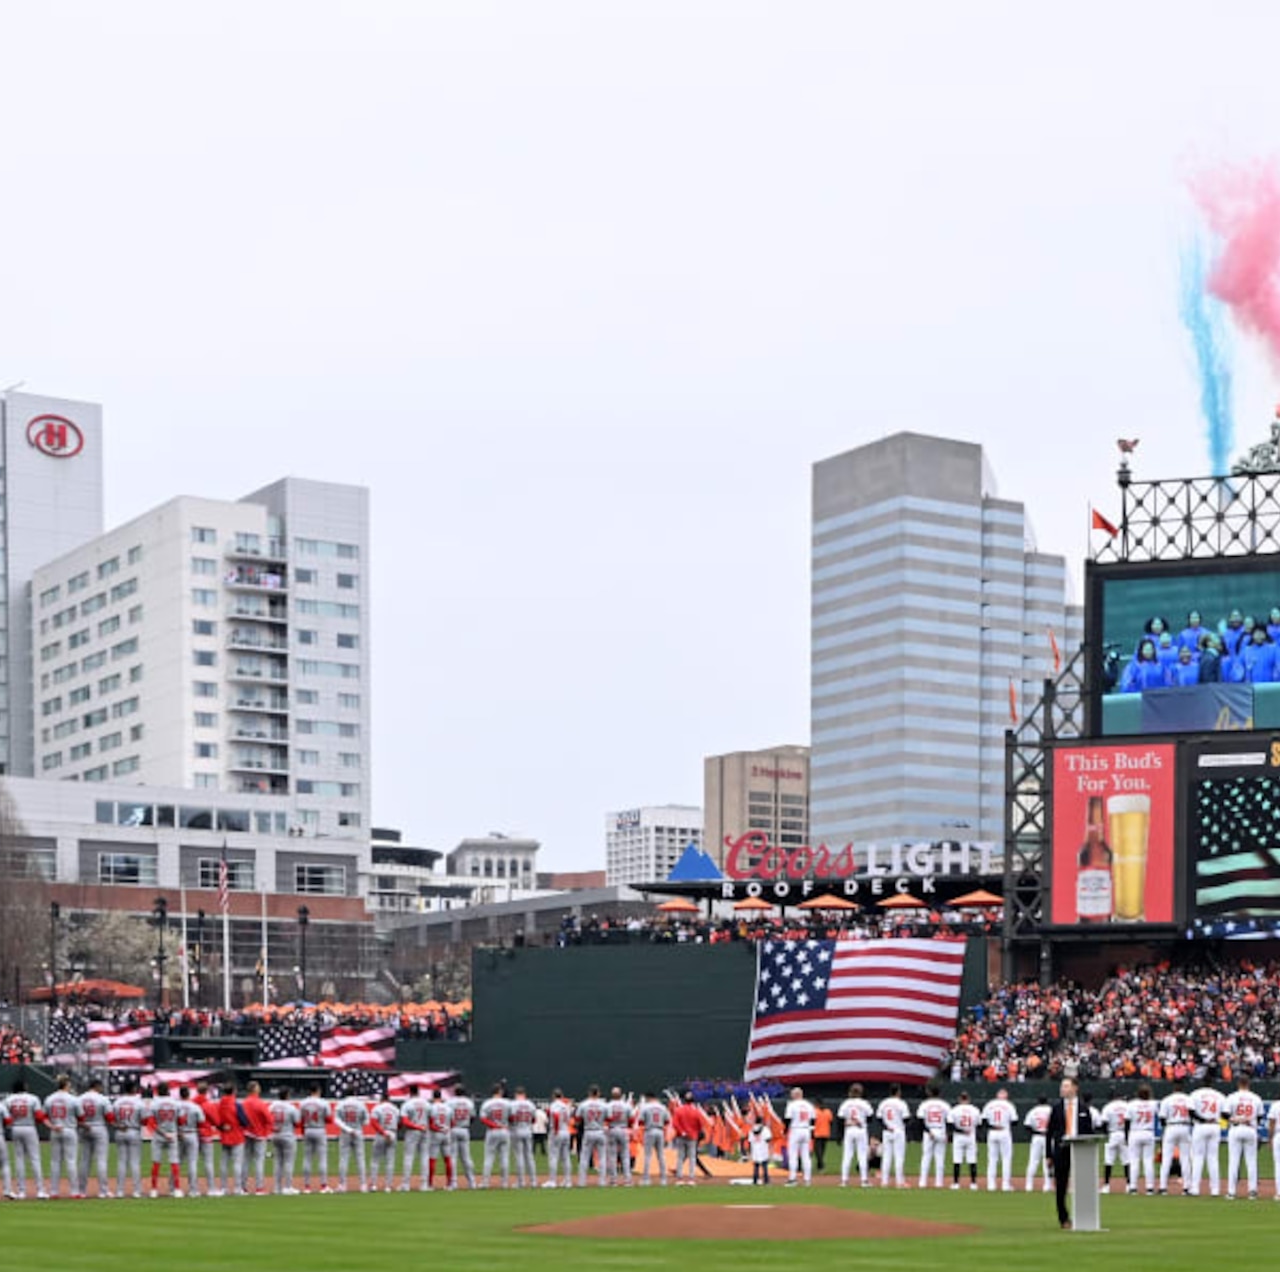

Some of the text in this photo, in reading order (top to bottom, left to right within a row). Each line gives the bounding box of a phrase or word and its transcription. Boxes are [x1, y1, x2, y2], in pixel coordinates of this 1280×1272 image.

[1065, 751, 1162, 771] This Bud's
[1077, 773, 1151, 791] For You.
[724, 830, 995, 879] Coors LIGHT
[722, 877, 936, 898] ROOF DECK
